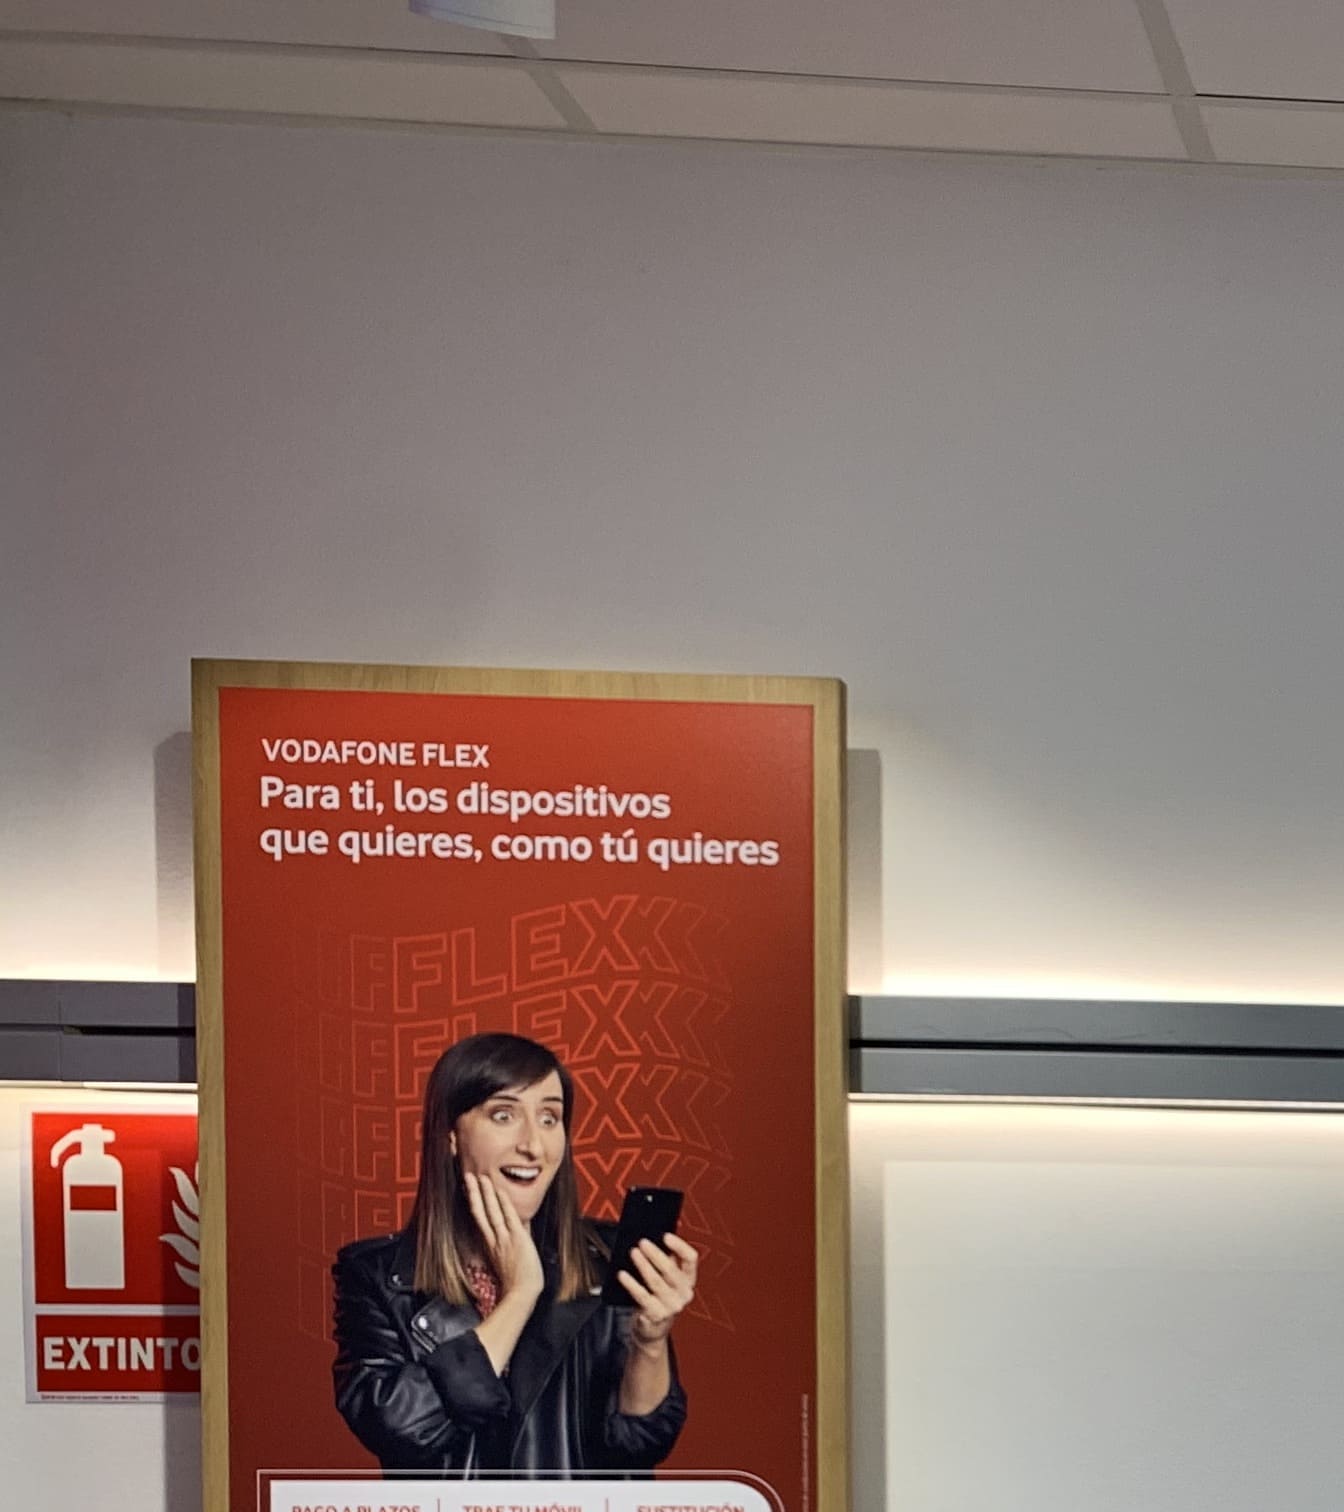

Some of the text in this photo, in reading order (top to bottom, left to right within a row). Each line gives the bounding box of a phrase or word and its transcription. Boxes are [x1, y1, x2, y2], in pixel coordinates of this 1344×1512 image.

[261, 738, 490, 769] VODAFONE FLEX
[260, 775, 671, 823] Para ti, los dispositivos
[259, 824, 779, 872] que quieres, como tú quieres
